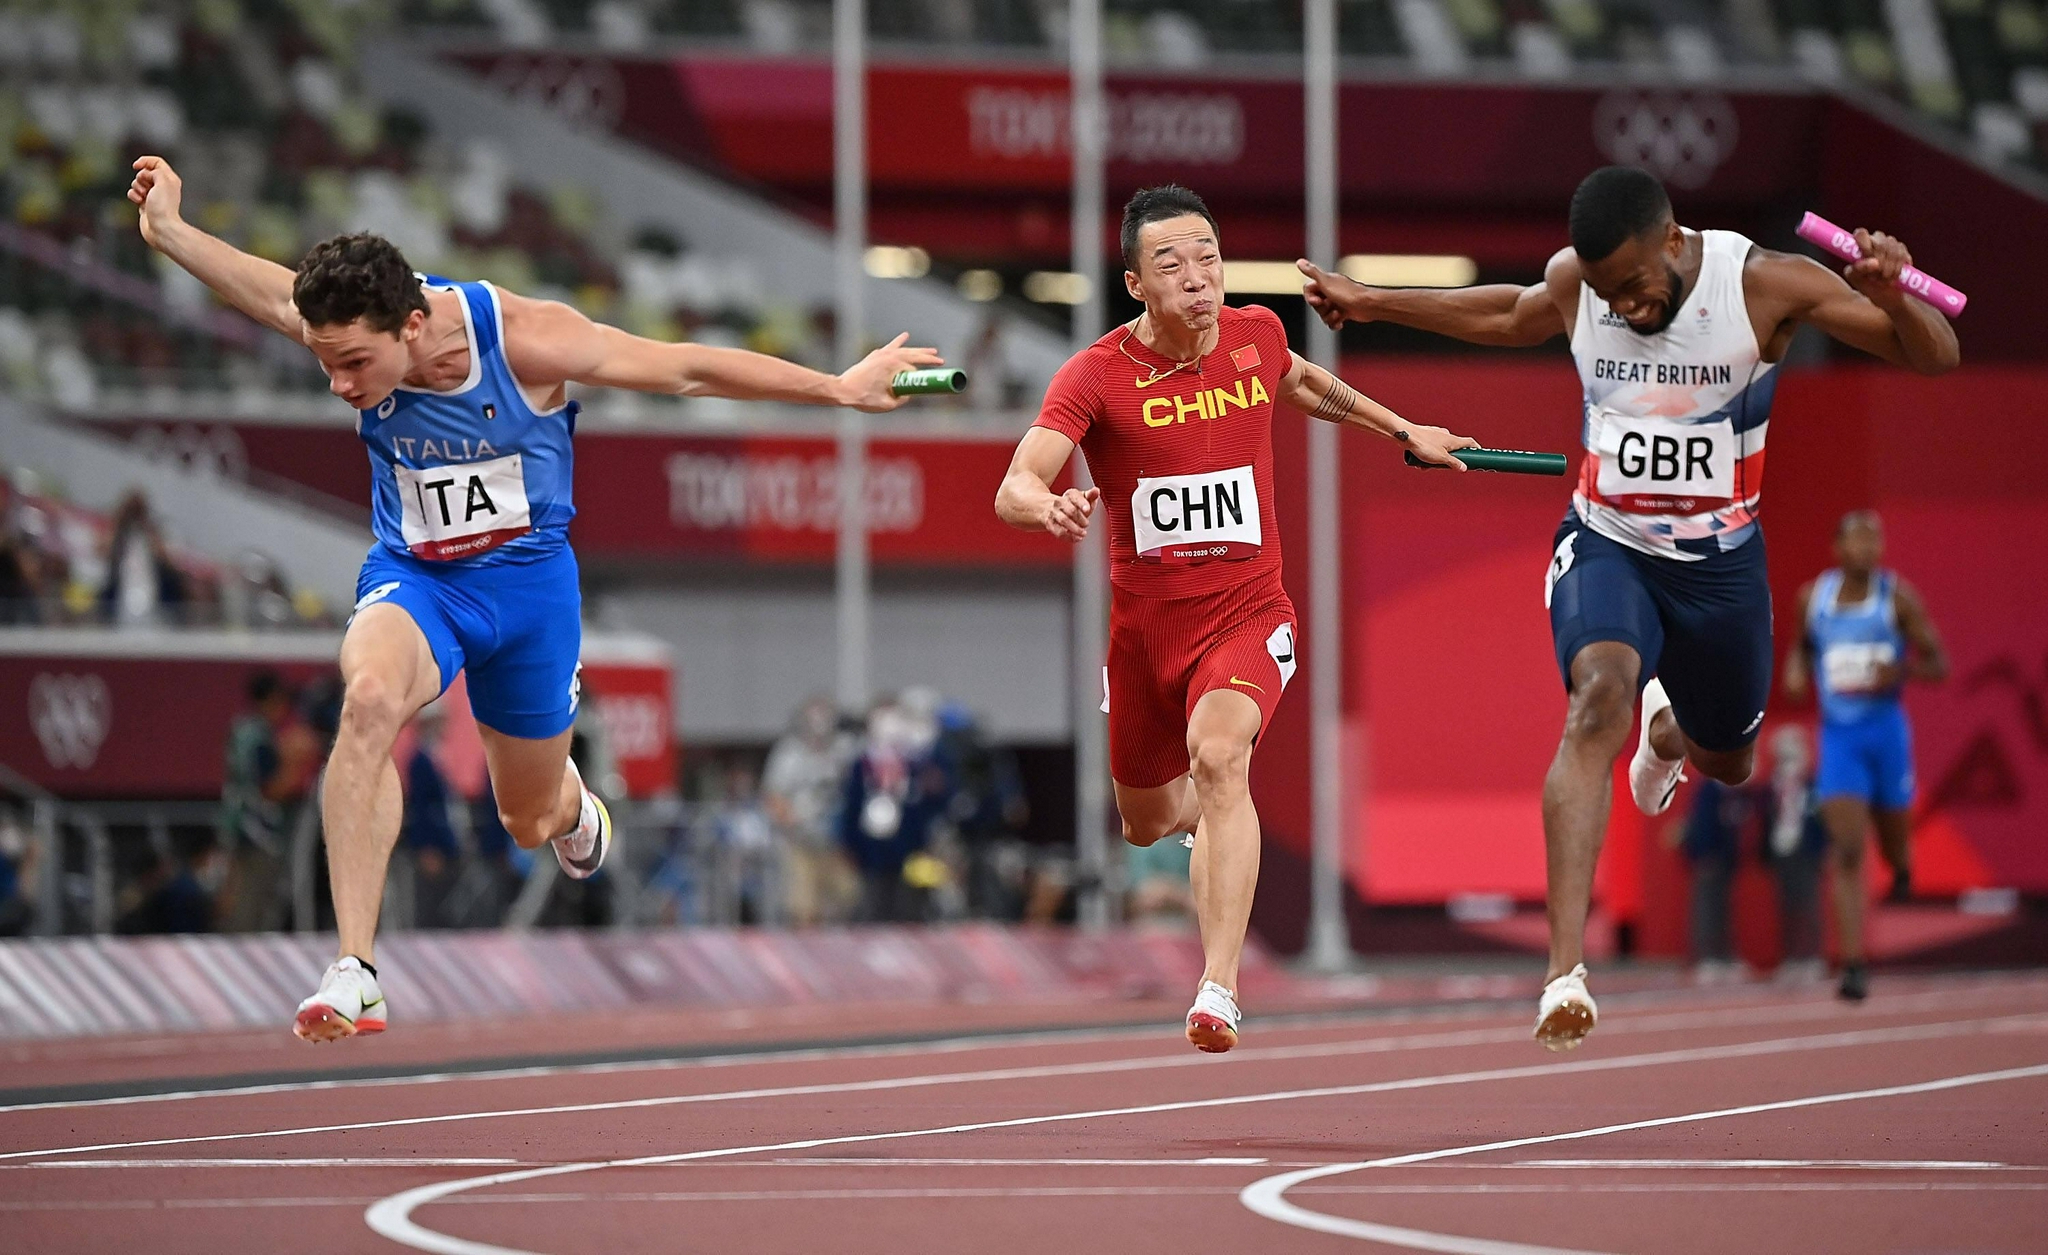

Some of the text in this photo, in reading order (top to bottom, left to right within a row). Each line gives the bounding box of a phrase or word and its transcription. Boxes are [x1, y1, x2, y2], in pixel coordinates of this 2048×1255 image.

[1595, 358, 1731, 385] GREAT BRITAIN
[1142, 375, 1271, 428] CHINA
[392, 435, 498, 460] ITALIA
[1618, 431, 1714, 482] GBR
[415, 474, 498, 527] ITA
[1150, 480, 1244, 532] CHN
[1173, 549, 1208, 558] TOKYO 2020
